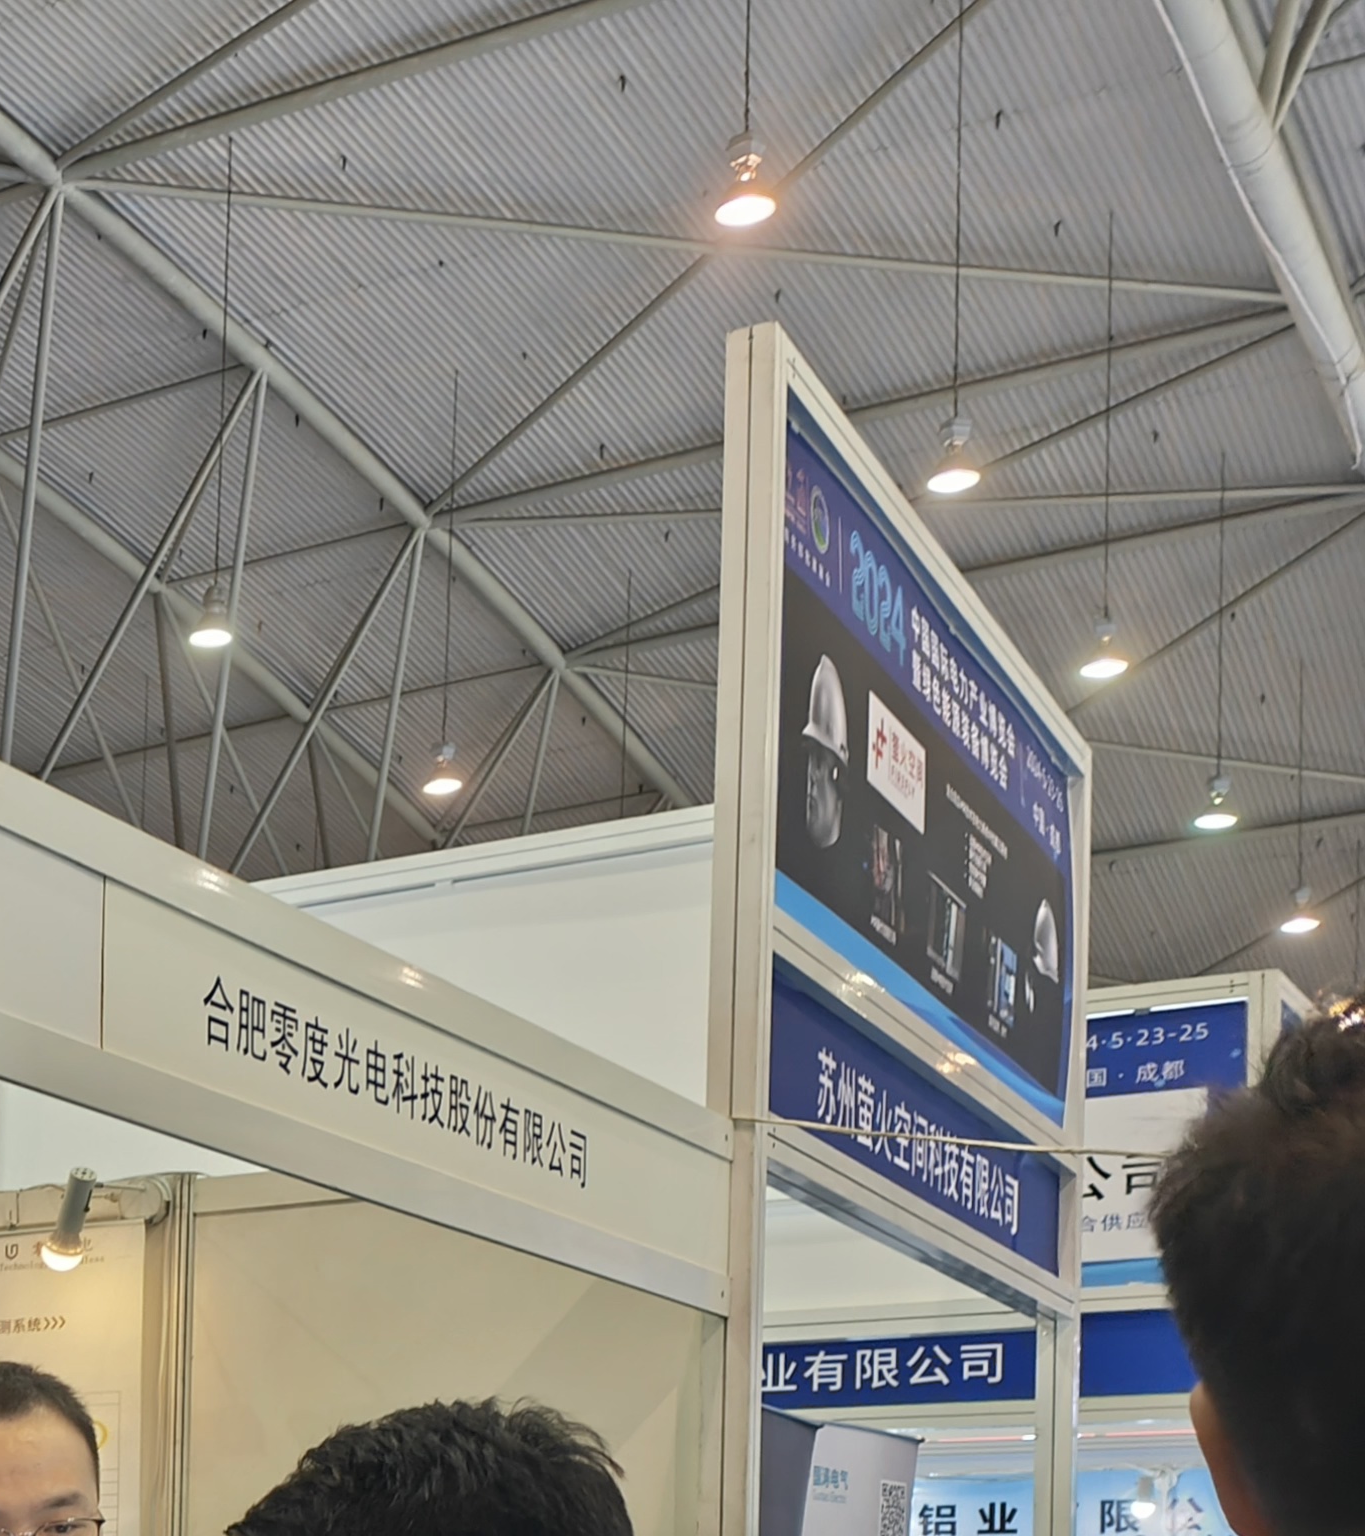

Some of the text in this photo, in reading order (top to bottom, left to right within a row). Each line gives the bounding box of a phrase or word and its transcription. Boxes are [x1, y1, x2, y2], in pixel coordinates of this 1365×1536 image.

[850, 530, 906, 667] 2024
[203, 975, 589, 1188] 合肥零度光电科技股份有限公司
[817, 1047, 1019, 1235] 苏州萤火空间科技有限公司
